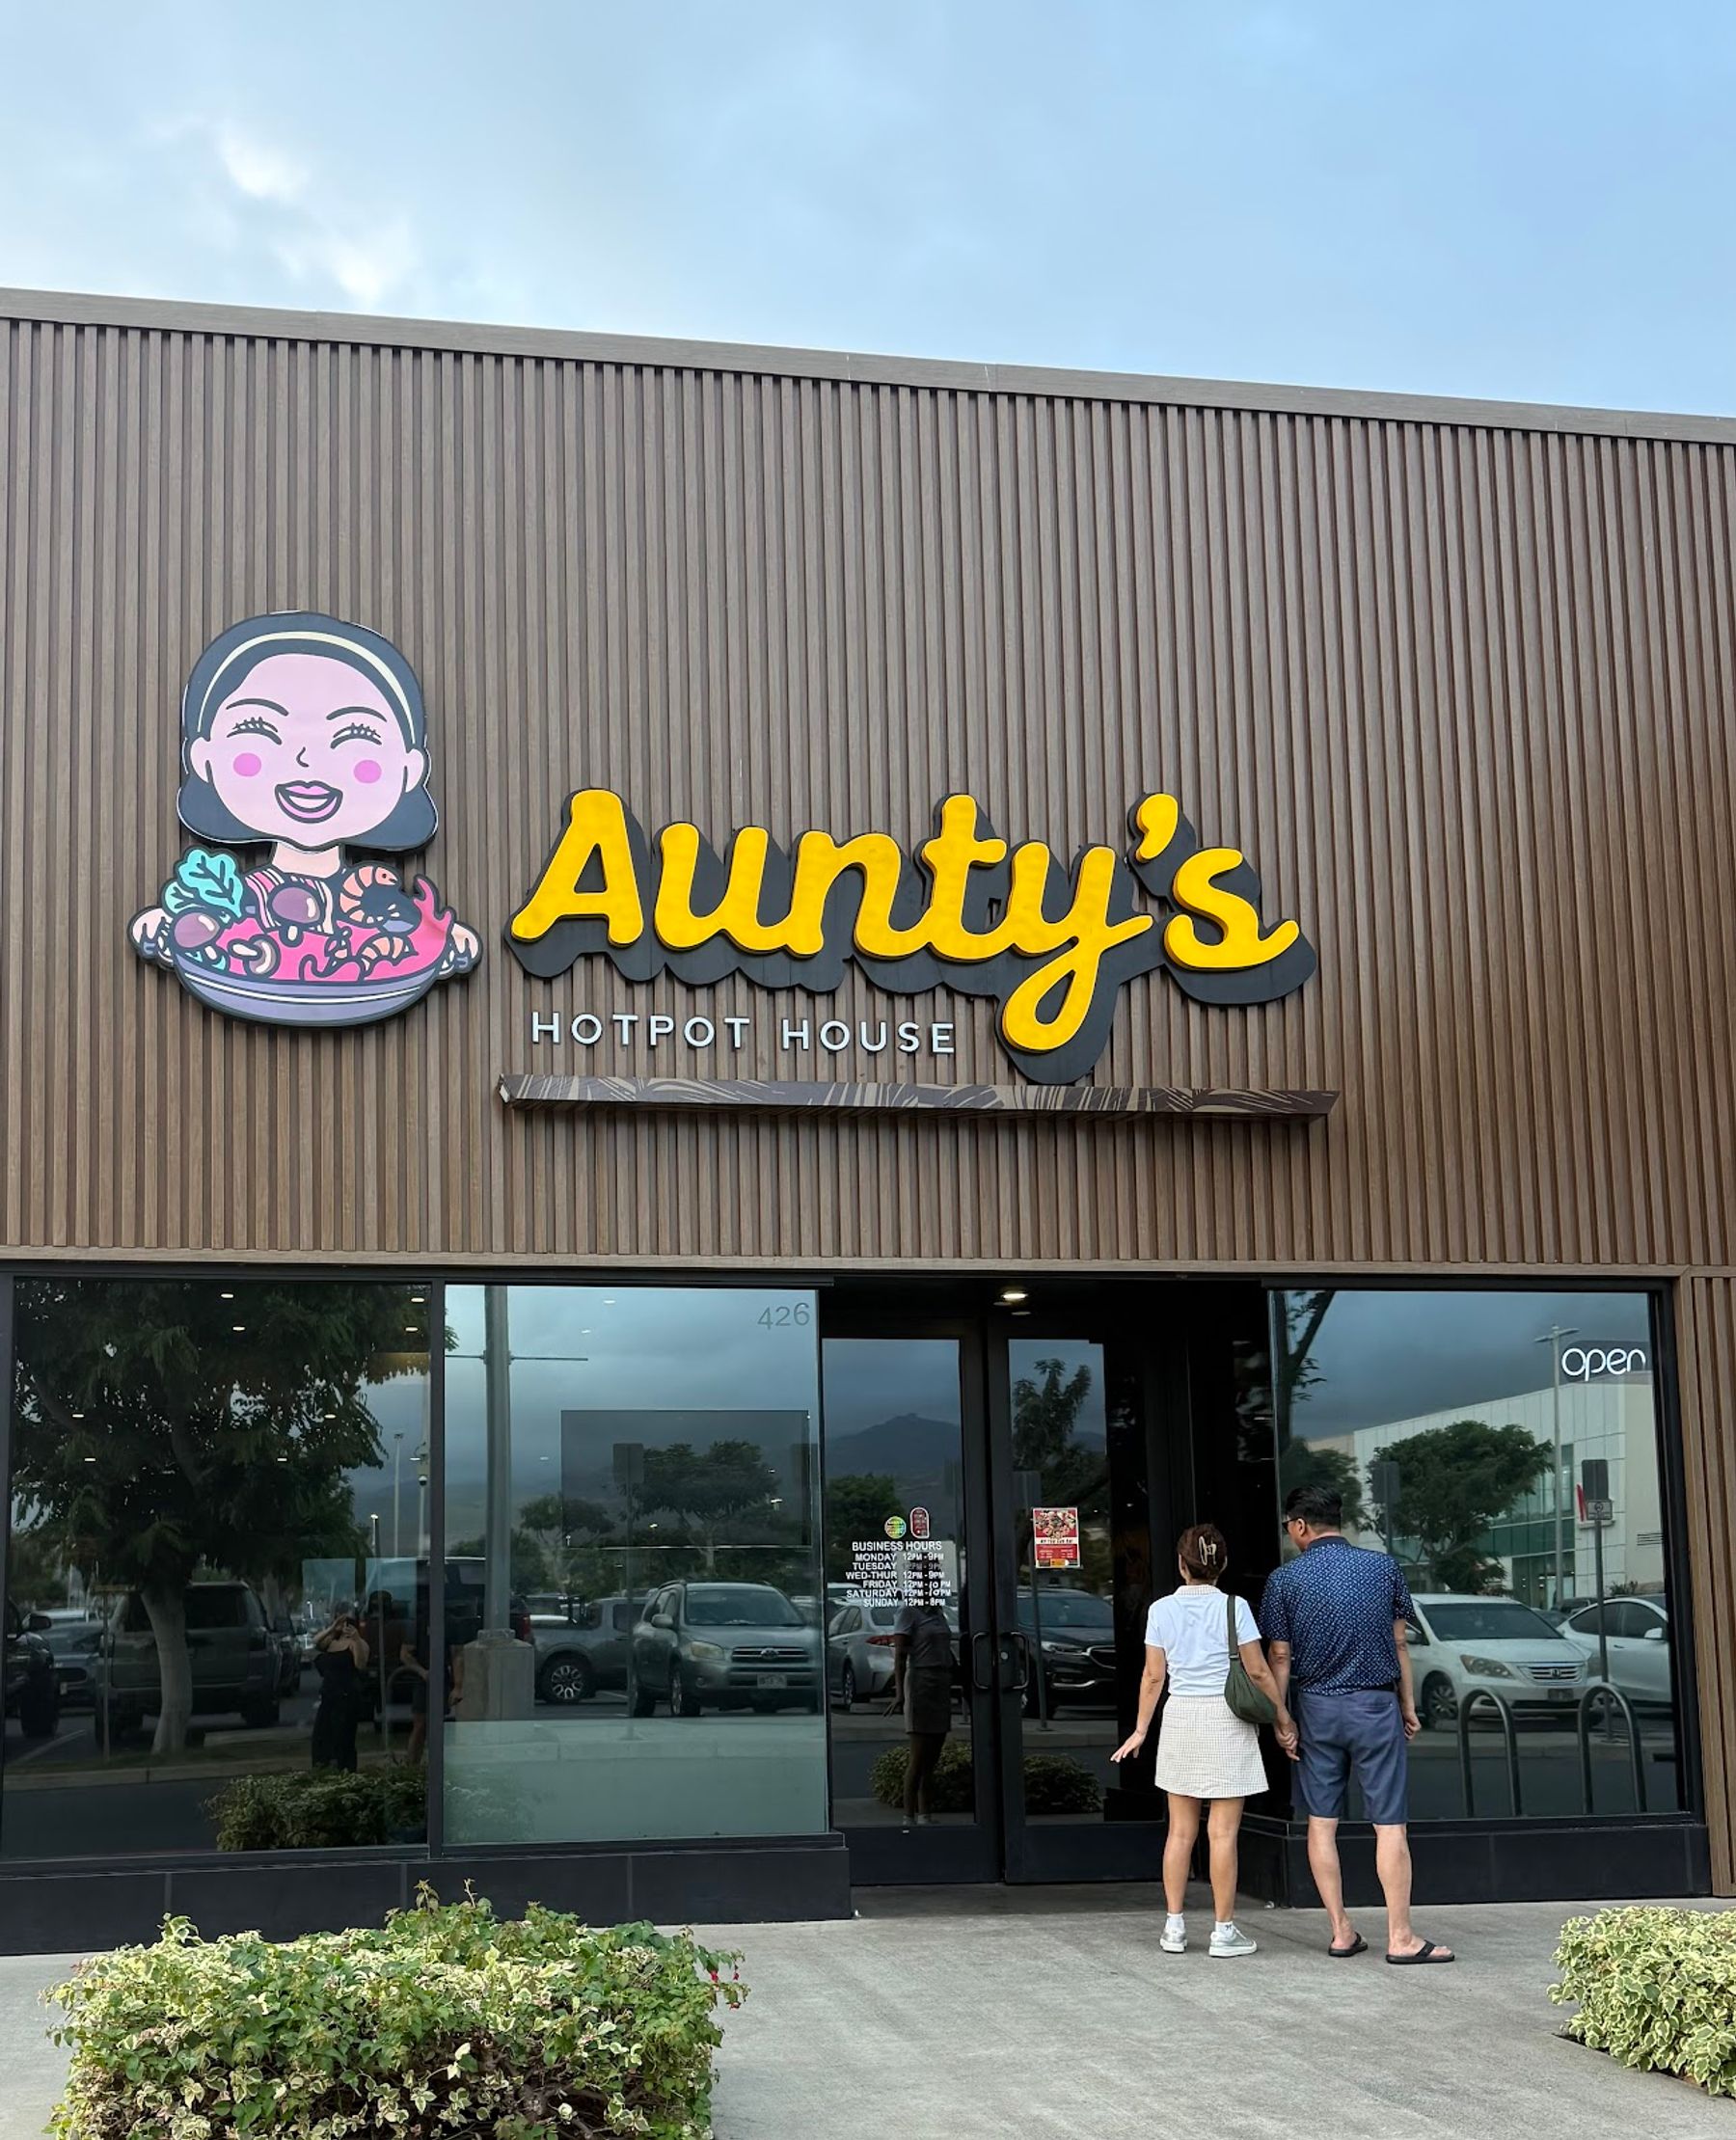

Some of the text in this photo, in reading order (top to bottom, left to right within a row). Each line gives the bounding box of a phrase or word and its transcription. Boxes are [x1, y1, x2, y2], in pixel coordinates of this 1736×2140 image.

[510, 787, 1300, 1051] Aunty's
[530, 1011, 955, 1054] HOTPOT HOUSE
[757, 1302, 810, 1330] 426
[1561, 1347, 1646, 1382] open
[852, 1540, 942, 1552] BUSINESS HOURS
[854, 1553, 897, 1562] MONDAY
[903, 1552, 923, 1561] 12PM
[853, 1561, 897, 1571] TUESDAY
[845, 1571, 897, 1580] WED-THUR
[903, 1571, 923, 1581] 12PM
[862, 1580, 897, 1589] FRIDAY
[903, 1580, 924, 1589] 12PM
[846, 1589, 898, 1599] SATURDAY
[904, 1588, 924, 1598] 12PM
[863, 1598, 899, 1608] SUNDAY
[904, 1598, 925, 1608] 12PM
[929, 1597, 946, 1608] 8PM
